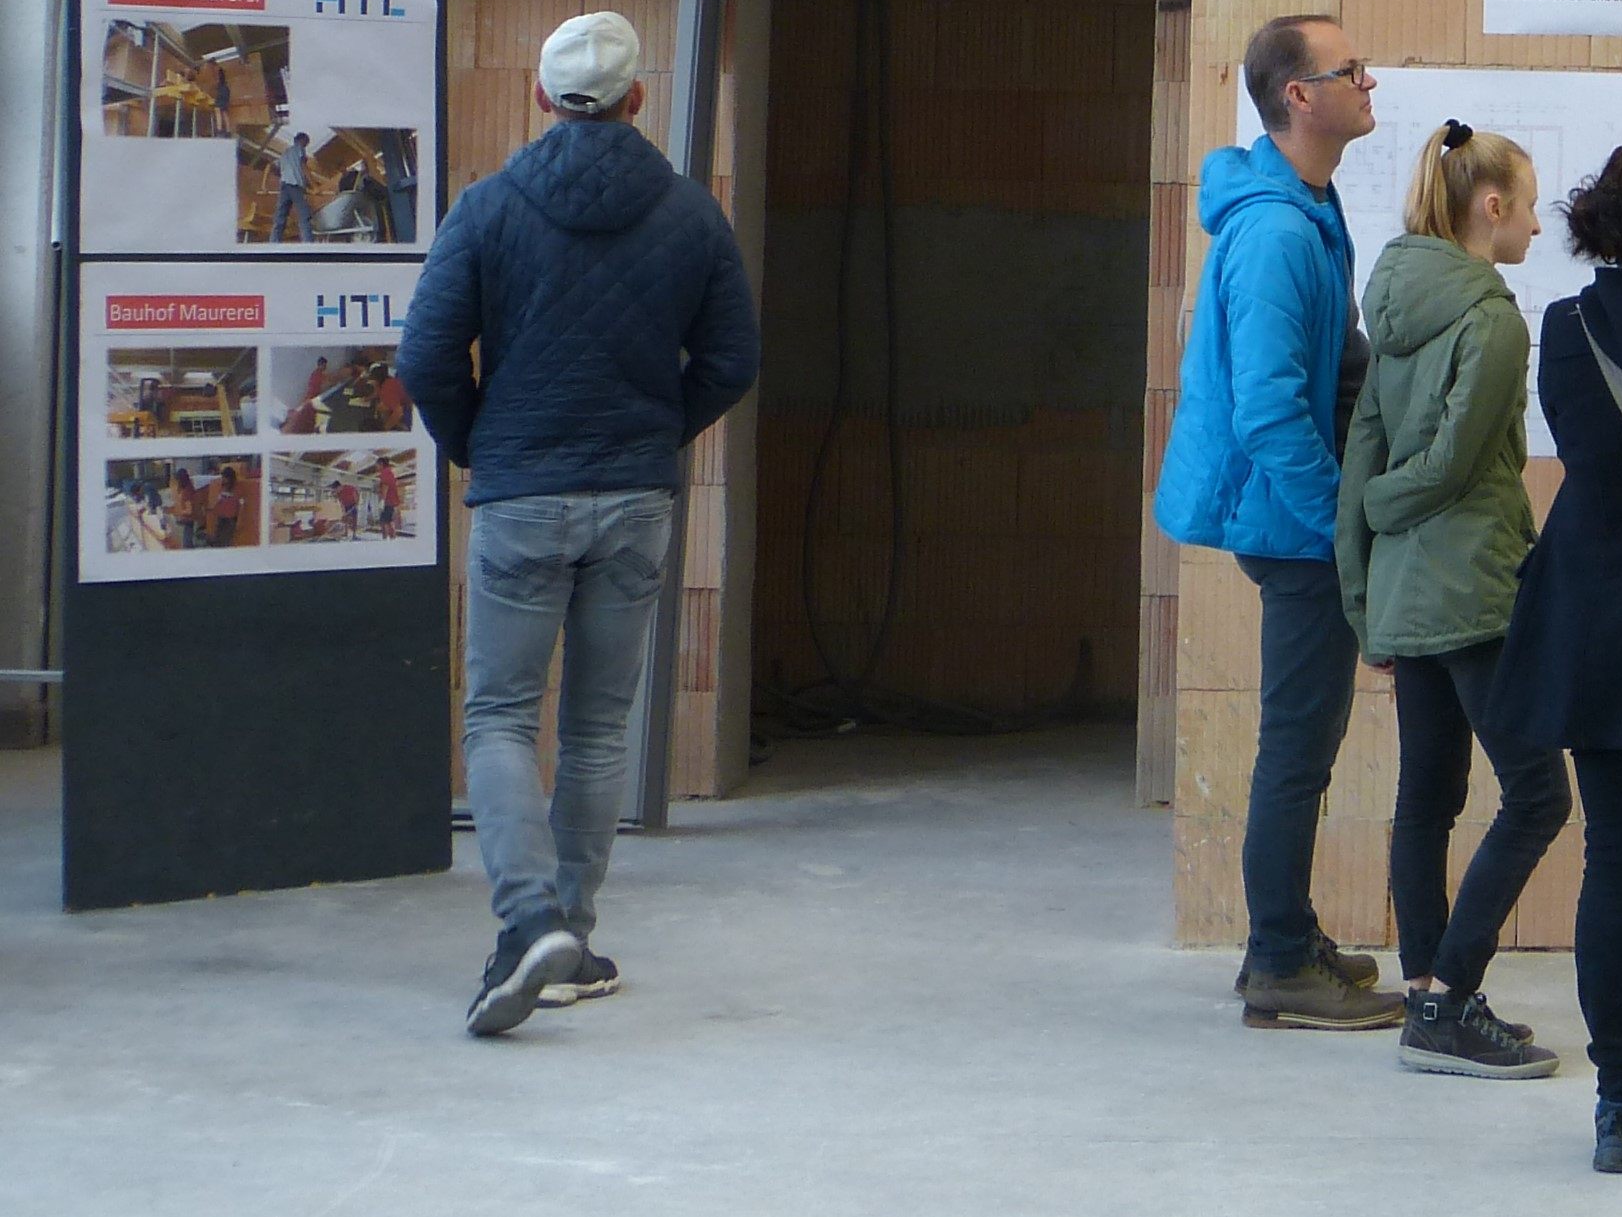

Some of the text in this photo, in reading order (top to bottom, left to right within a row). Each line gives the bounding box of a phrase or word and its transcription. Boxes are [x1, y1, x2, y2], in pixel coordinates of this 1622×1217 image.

[110, 295, 406, 328] Bauhof Maurerei HTL
